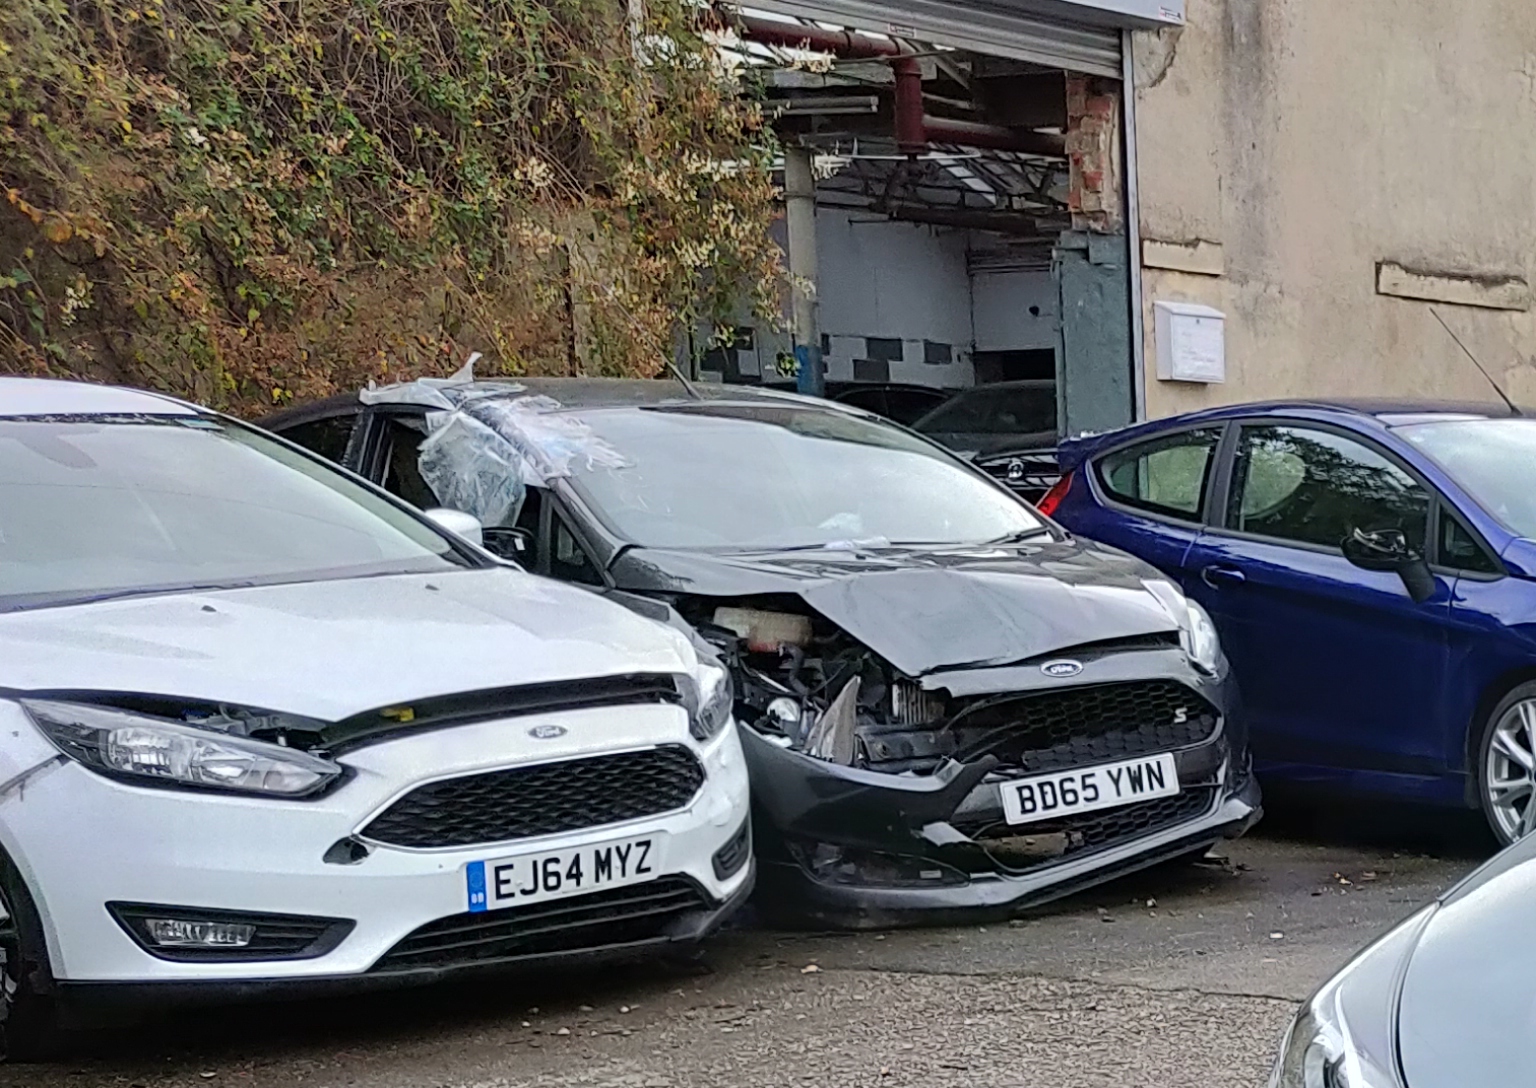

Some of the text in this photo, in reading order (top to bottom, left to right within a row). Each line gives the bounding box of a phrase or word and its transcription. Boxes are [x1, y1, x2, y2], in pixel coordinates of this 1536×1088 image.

[1016, 761, 1166, 815] BD65 YWN
[494, 839, 652, 900] EJ64 MYZ
